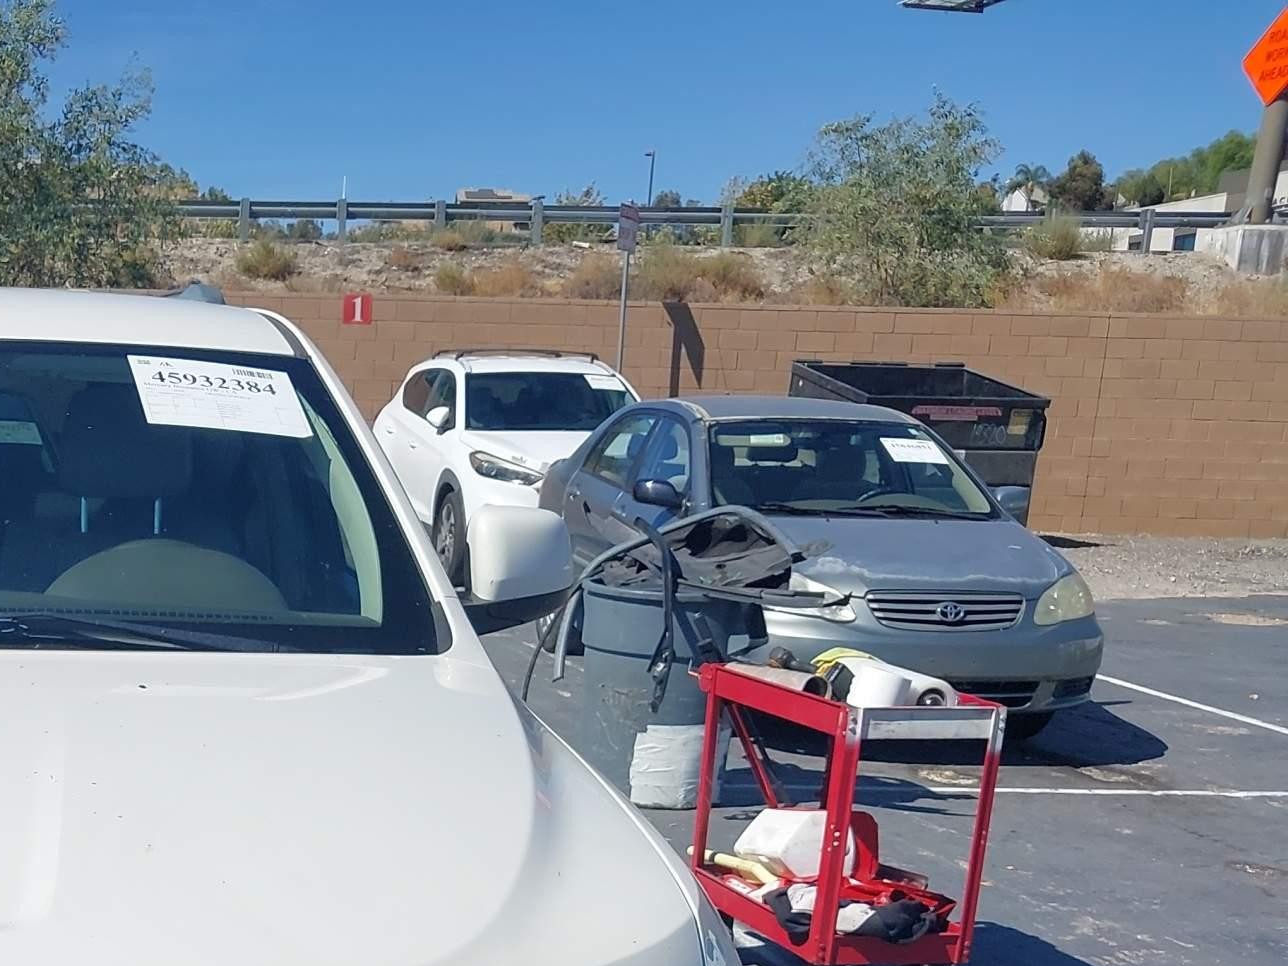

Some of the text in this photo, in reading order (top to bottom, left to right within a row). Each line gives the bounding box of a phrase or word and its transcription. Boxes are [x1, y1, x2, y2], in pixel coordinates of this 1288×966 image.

[1269, 29, 1288, 43] ROA
[351, 295, 363, 322] 1
[152, 370, 277, 396] 45932384
